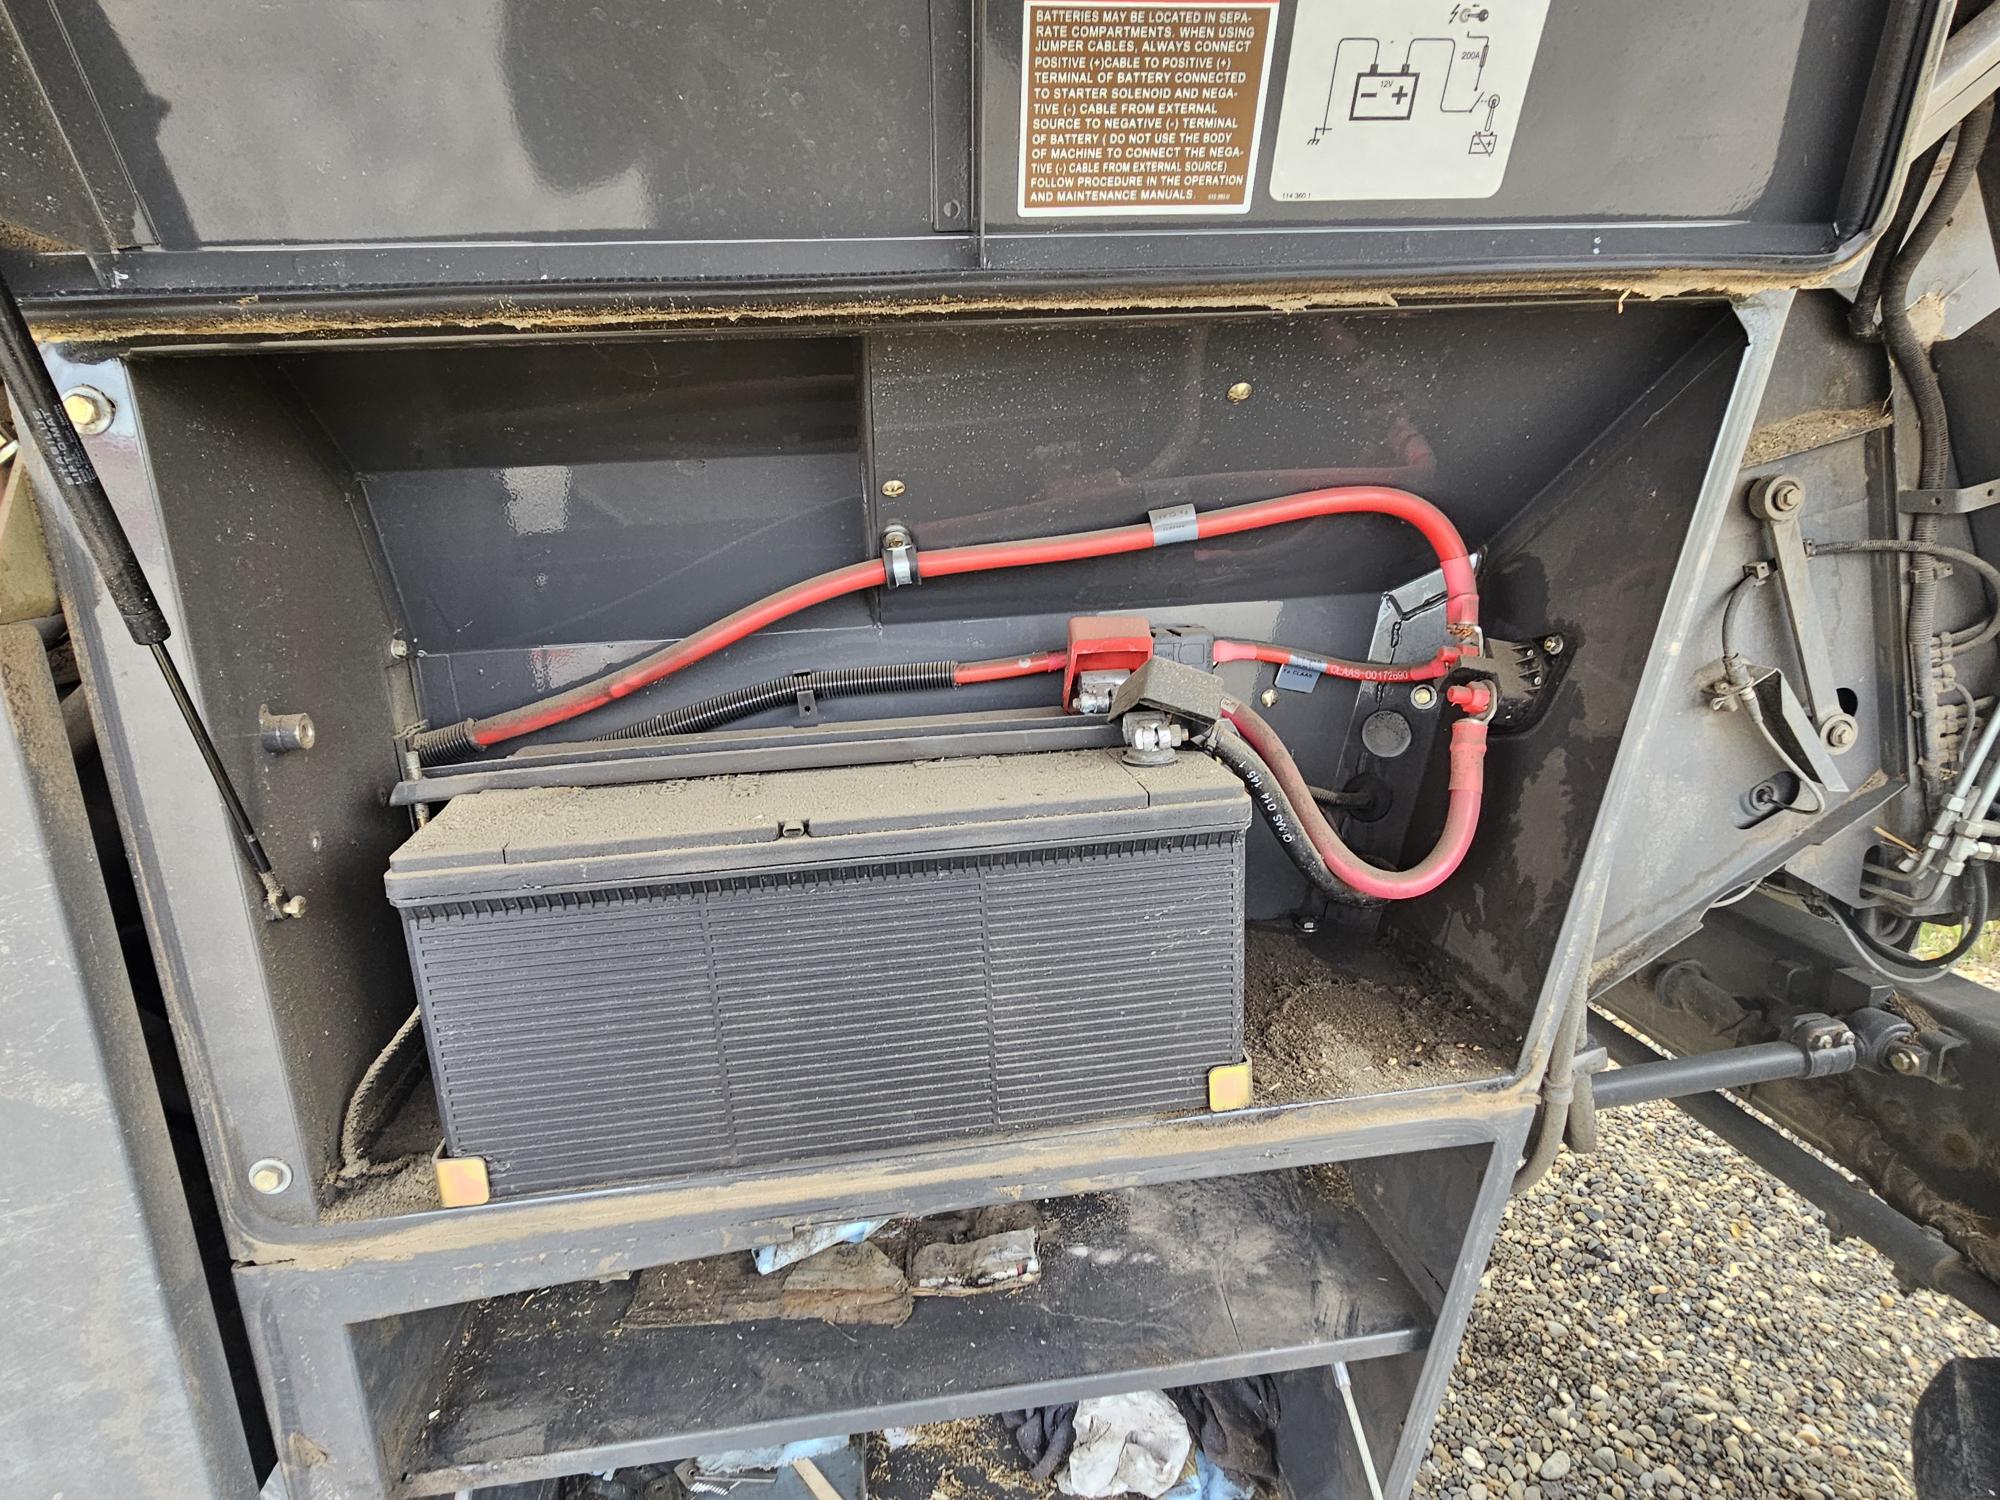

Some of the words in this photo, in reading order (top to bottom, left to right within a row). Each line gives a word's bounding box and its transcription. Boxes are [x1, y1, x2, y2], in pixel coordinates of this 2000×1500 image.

[1037, 10, 1098, 22] BATTERIES
[1103, 11, 1126, 22] MAY
[1131, 11, 1144, 22] BE
[1149, 12, 1200, 23] LOCATED
[1205, 12, 1215, 22] IN
[1220, 12, 1251, 23] SEPA-
[1037, 26, 1067, 37] RATE
[1072, 26, 1175, 37] COMPARTMENTS.
[1180, 27, 1214, 38] WHEN
[1219, 27, 1254, 38] USING
[1036, 40, 1083, 51] JUMPER
[1088, 40, 1137, 53] CABLES,
[1142, 41, 1190, 51] ALWAYS
[1195, 41, 1251, 52] CONNECT
[1461, 51, 1480, 60] 200A
[1035, 57, 1085, 68] POSITIVE
[1145, 57, 1159, 68] TO
[1163, 57, 1212, 68] POSITIVE
[1035, 72, 1092, 83] TERMINAL
[1098, 72, 1113, 83] OF
[1118, 72, 1171, 83] BATTERY
[1175, 72, 1246, 83] CONNECTED
[1380, 80, 1394, 88] 12V
[1034, 88, 1049, 98] TO
[1054, 88, 1107, 99] STARTER
[1112, 88, 1171, 98] SOLENOID
[1175, 88, 1198, 98] AND
[1203, 88, 1237, 98] NEGA-
[1034, 104, 1059, 114] TIVE
[1080, 103, 1117, 114] CABLE
[1122, 103, 1154, 114] FROM
[1159, 103, 1217, 114] EXTERNAL
[1033, 118, 1080, 129] SOURCE
[1085, 118, 1100, 128] TO
[1105, 118, 1162, 128] NEGATIVE
[1183, 118, 1237, 128] TERMINAL
[1032, 134, 1046, 144] OF
[1051, 134, 1099, 144] BATTERY
[1129, 133, 1151, 144] NOT
[1155, 133, 1175, 143] USE
[1180, 133, 1200, 143] THE
[1203, 133, 1232, 143] BODY
[1032, 149, 1047, 159] OF
[1051, 148, 1102, 159] MACHINE
[1107, 148, 1122, 158] TO
[1126, 147, 1180, 158] CONNECT
[1185, 147, 1205, 157] THE
[1210, 147, 1243, 157] NEGA-
[1032, 163, 1052, 173] TIVE
[1069, 163, 1099, 173] CABLE
[1103, 162, 1130, 172] FROM
[1133, 162, 1181, 172] EXTERNAL
[1185, 161, 1227, 173] SOURCE)
[1031, 177, 1074, 187] FOLLOW
[1078, 176, 1142, 186] PROCEDURE
[1147, 176, 1157, 186] IN
[1161, 176, 1180, 186] THE
[1184, 175, 1243, 185] OPERATION
[1030, 192, 1053, 202] AND
[1057, 190, 1137, 201] MAINTENANCE
[1141, 189, 1196, 200] MANUALS.
[32, 410, 74, 485] STABILUS
[1330, 665, 1360, 679] CLAAS
[1238, 760, 1246, 768] 1
[1246, 770, 1263, 788] 145
[1261, 792, 1277, 811] 014
